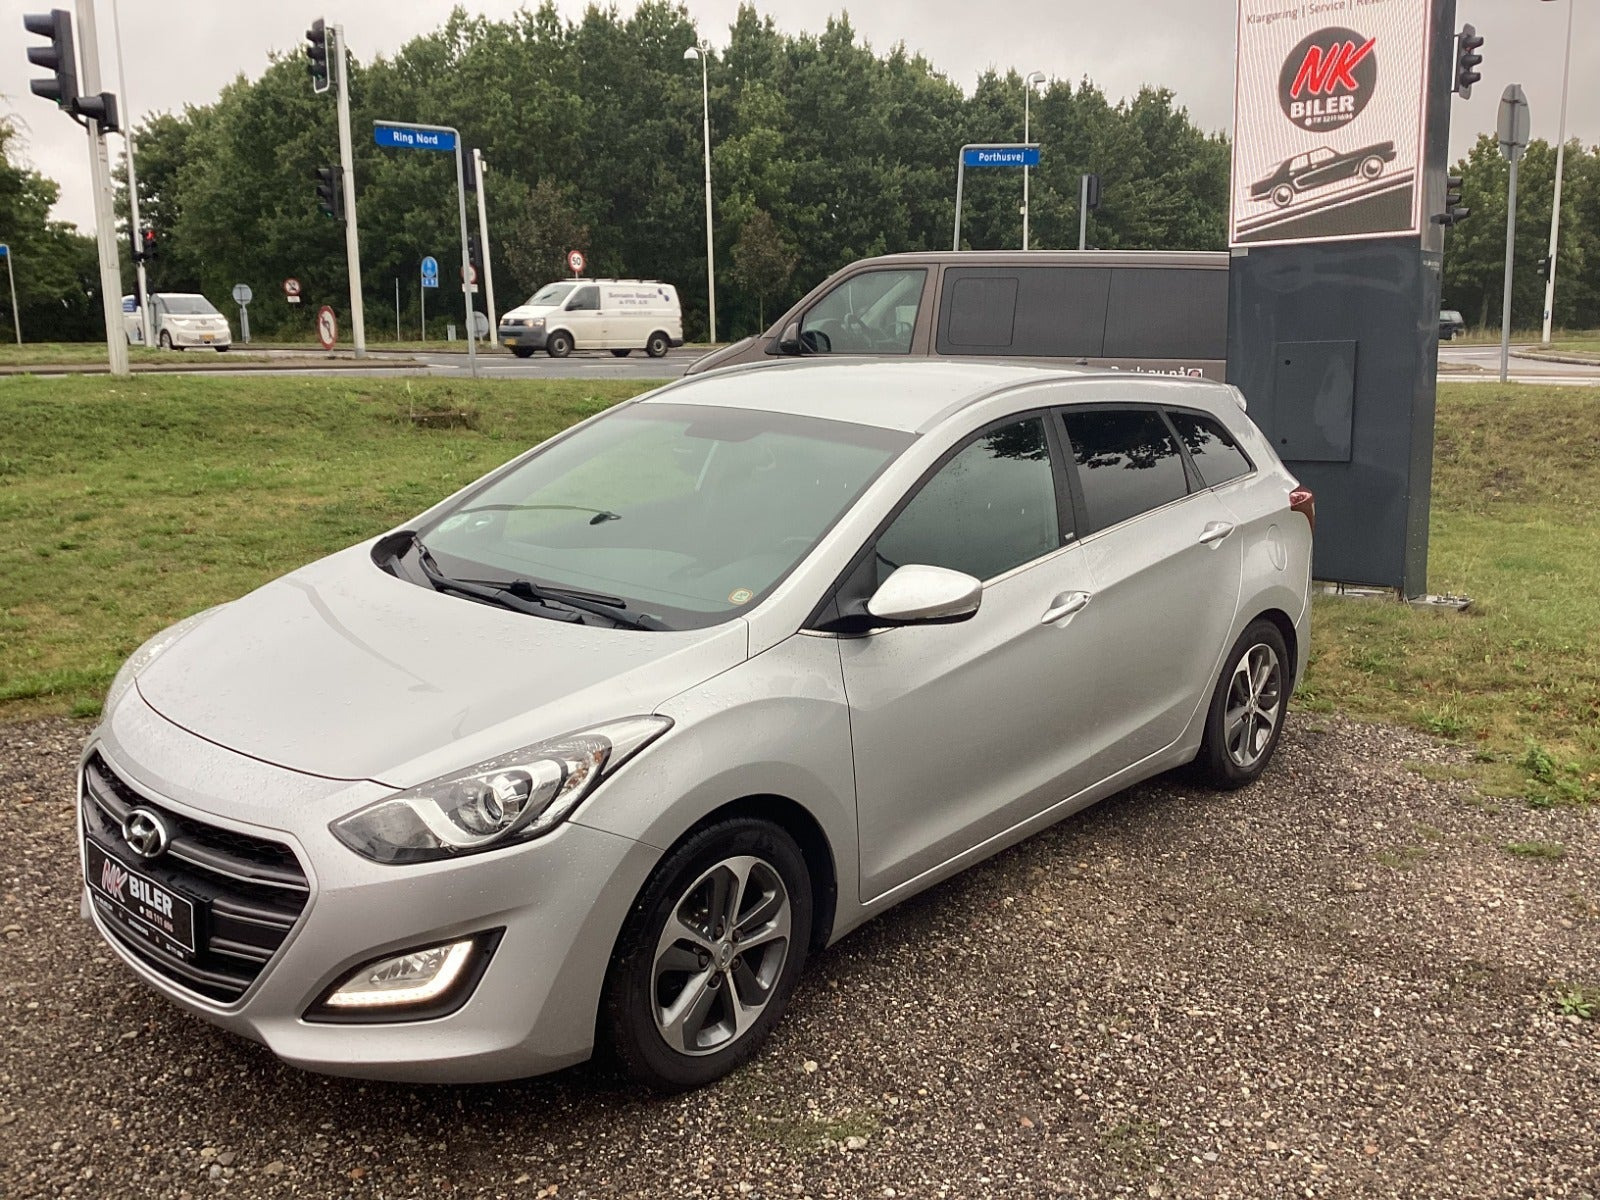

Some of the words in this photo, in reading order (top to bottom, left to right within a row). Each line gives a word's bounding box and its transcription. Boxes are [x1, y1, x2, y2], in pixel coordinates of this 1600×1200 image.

[1309, 2, 1346, 14] Service
[1290, 36, 1377, 99] NK
[1290, 94, 1355, 119] BILER
[393, 131, 413, 145] Ring
[416, 133, 438, 145] Nord
[978, 152, 1024, 162] Porthusvej
[572, 256, 581, 266] 50
[101, 858, 128, 903] NK
[129, 874, 173, 919] BILER
